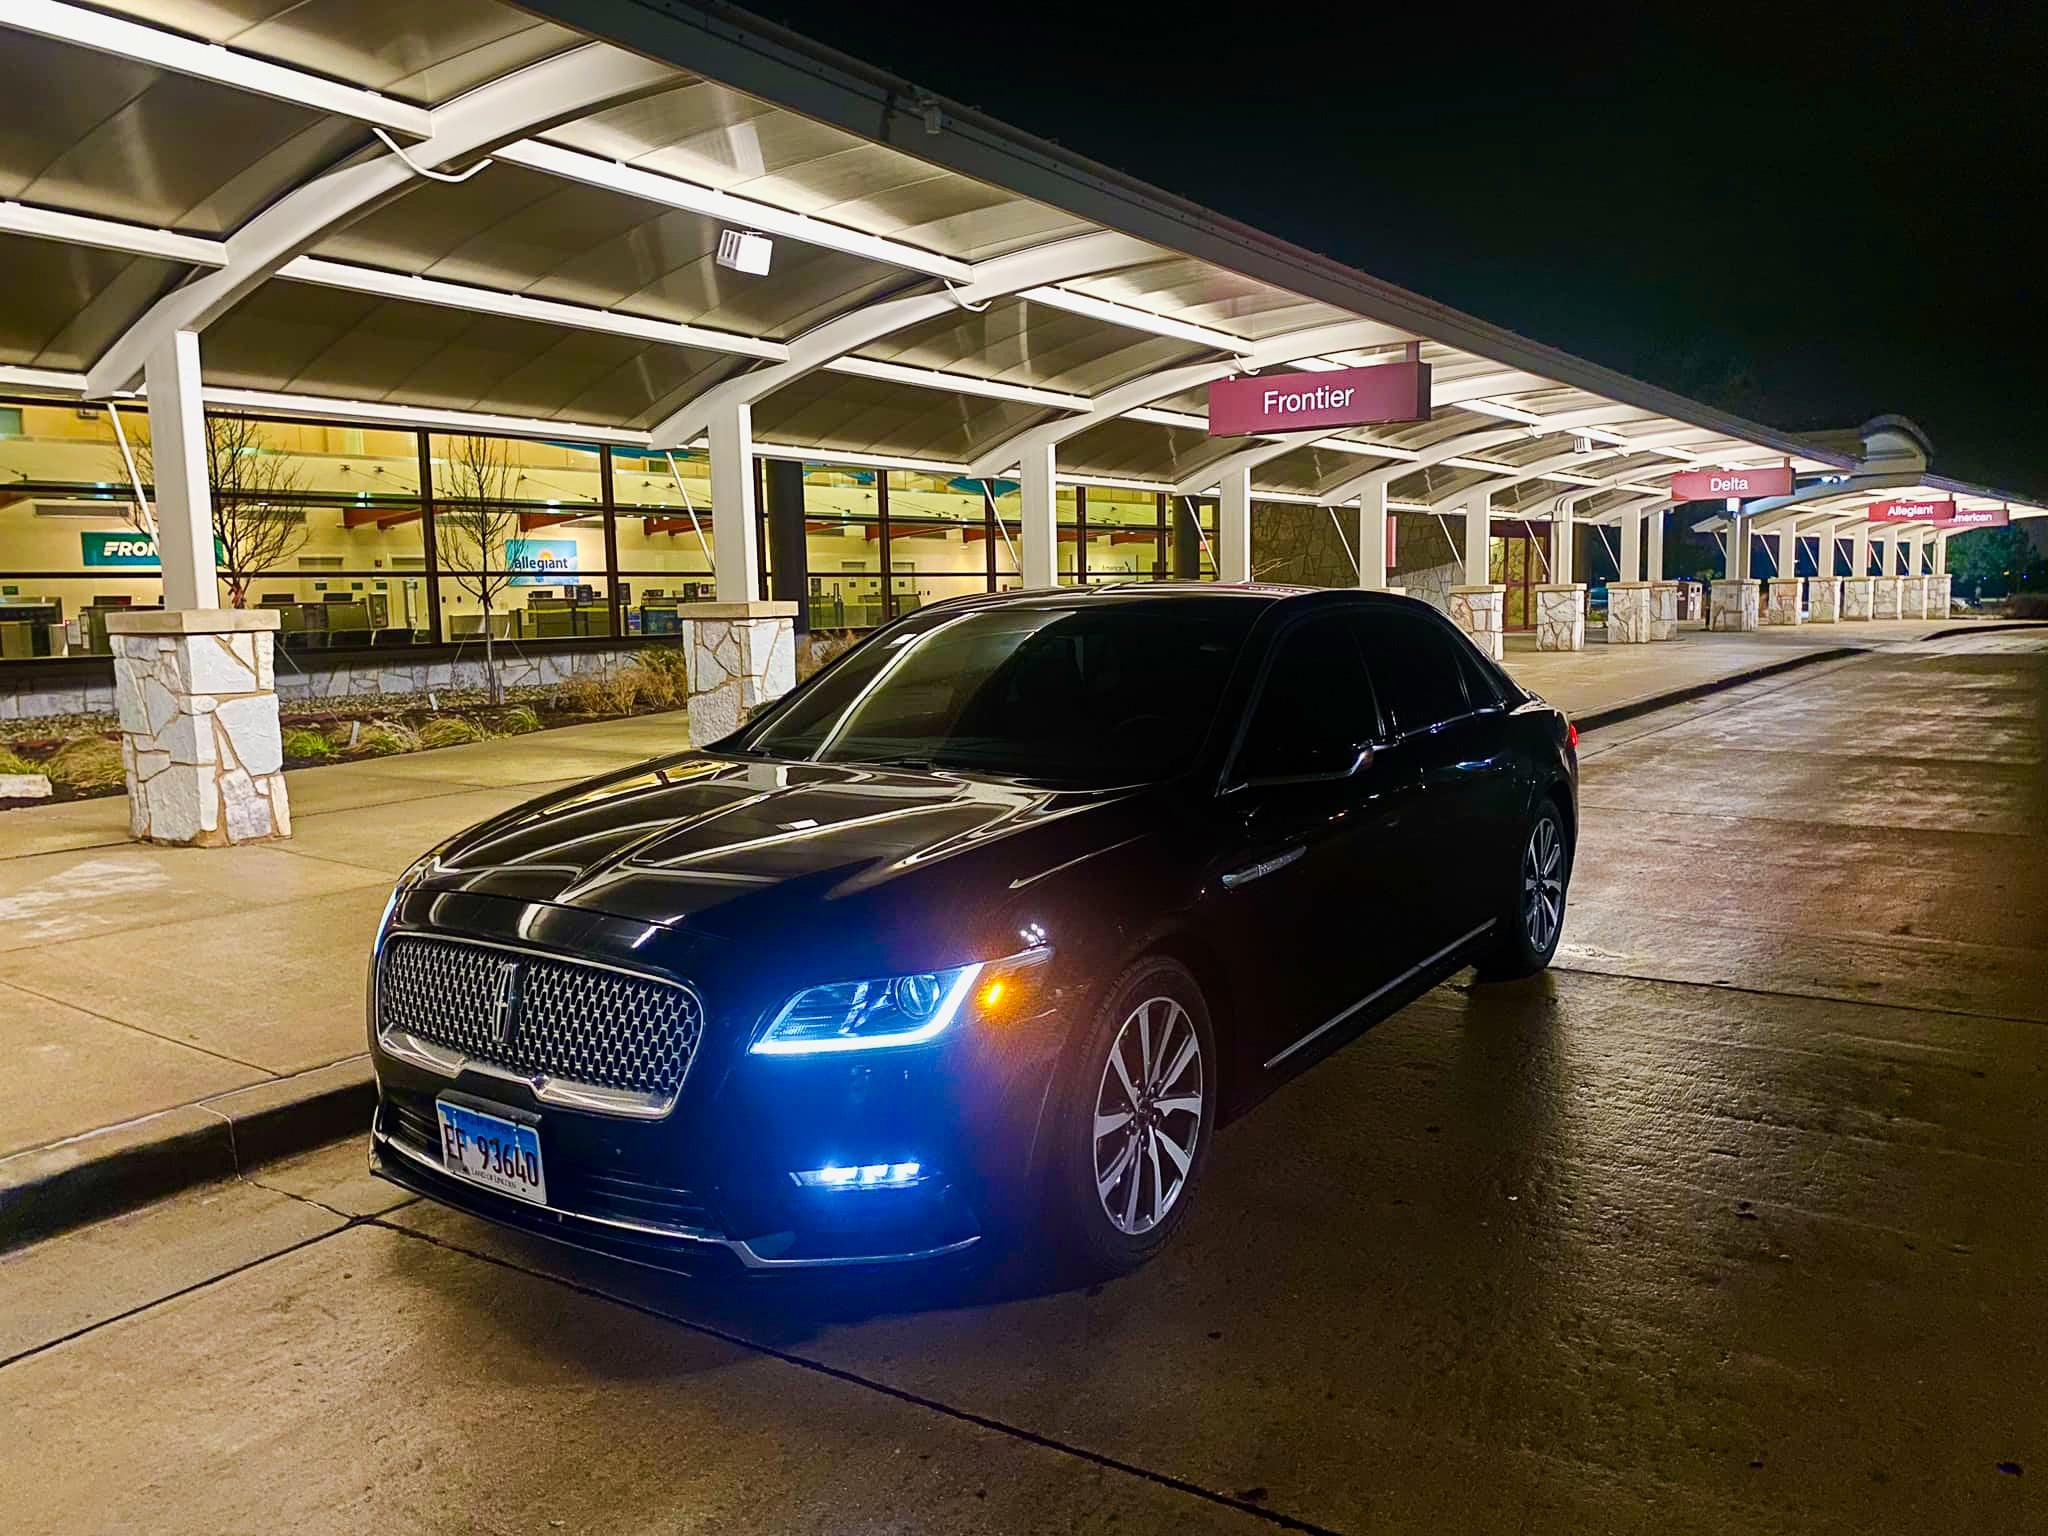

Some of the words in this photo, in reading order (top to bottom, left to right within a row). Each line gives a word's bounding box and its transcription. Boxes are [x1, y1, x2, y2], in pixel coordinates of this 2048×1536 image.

[1263, 385, 1354, 415] Frontier
[1710, 477, 1748, 492] Delta
[1887, 505, 1934, 518] Allegiant
[514, 556, 569, 577] allegiant
[443, 1123, 466, 1161] EF
[477, 1135, 539, 1187] 93640
